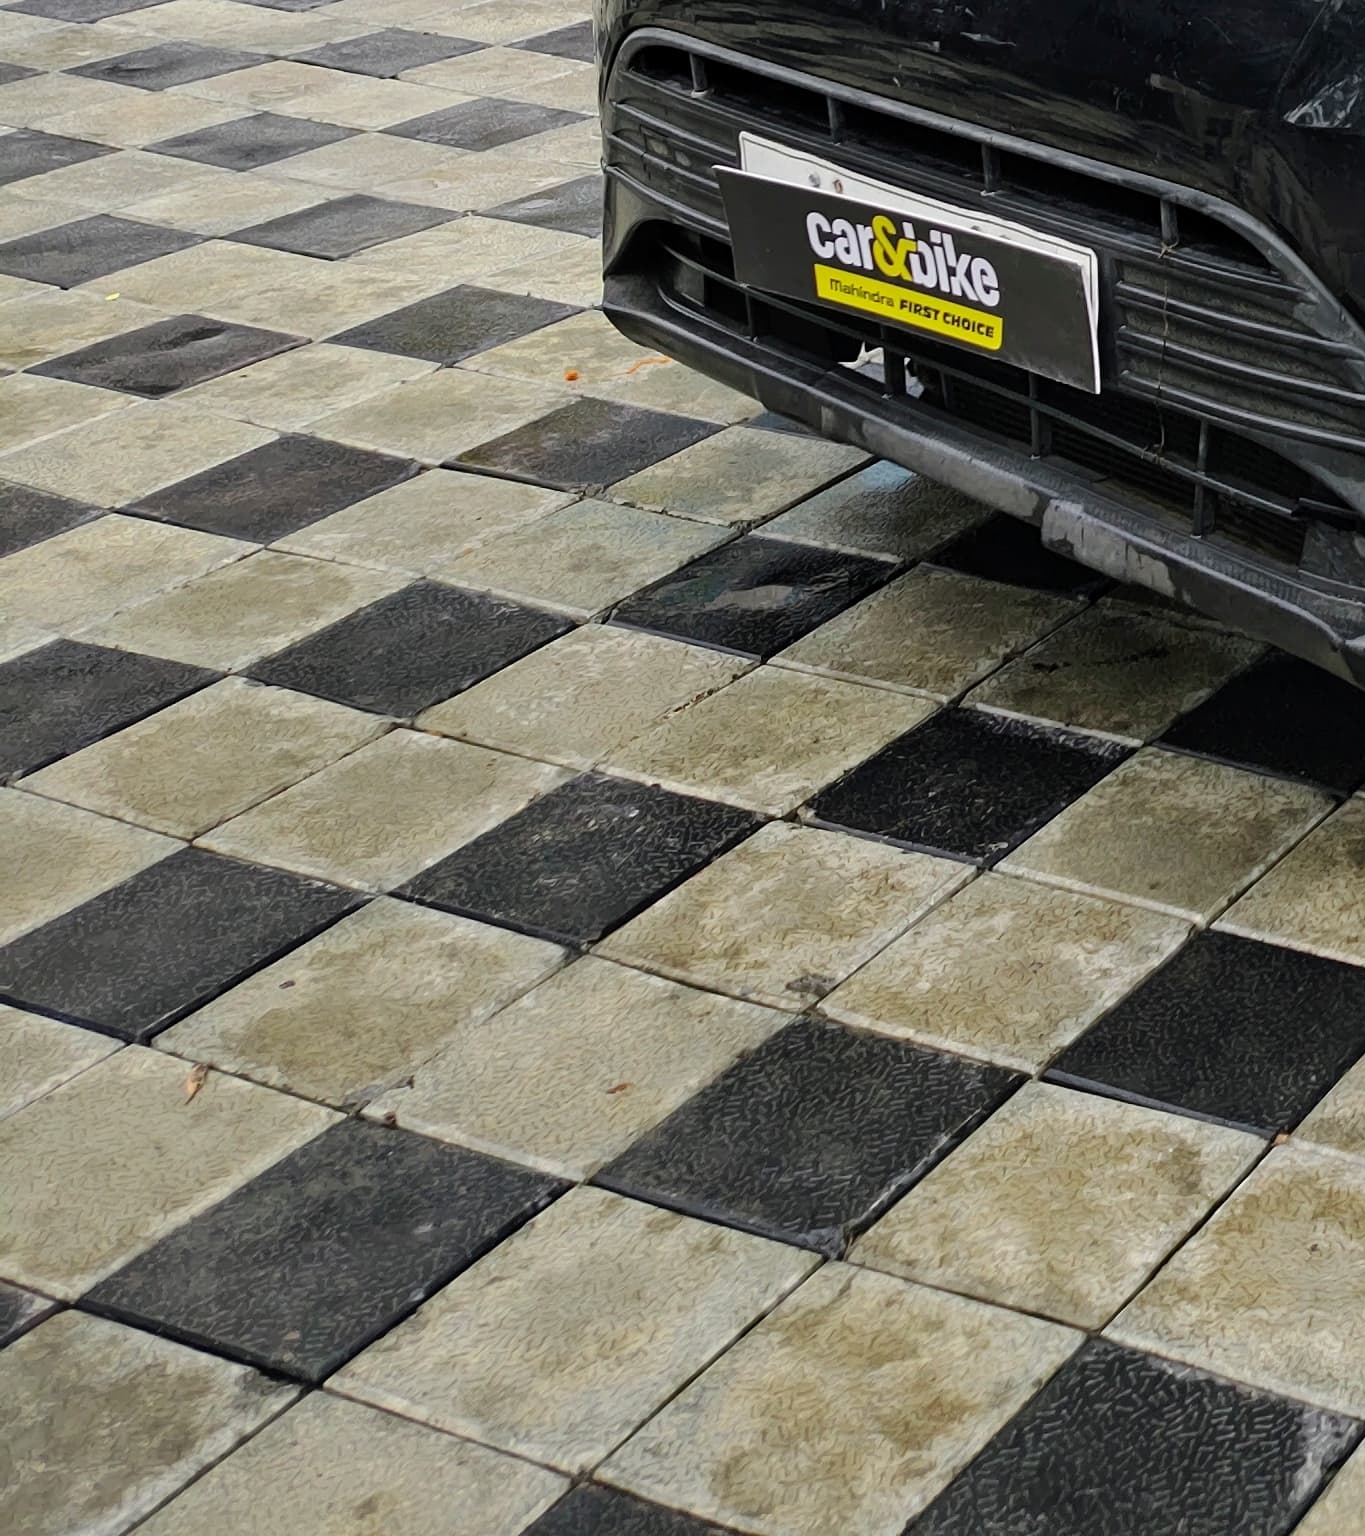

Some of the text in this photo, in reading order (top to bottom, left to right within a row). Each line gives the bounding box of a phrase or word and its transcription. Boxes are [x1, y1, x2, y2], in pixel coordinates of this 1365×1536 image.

[805, 210, 1001, 308] car&bike
[899, 299, 940, 323] FIRST
[942, 311, 996, 340] CHOICE
